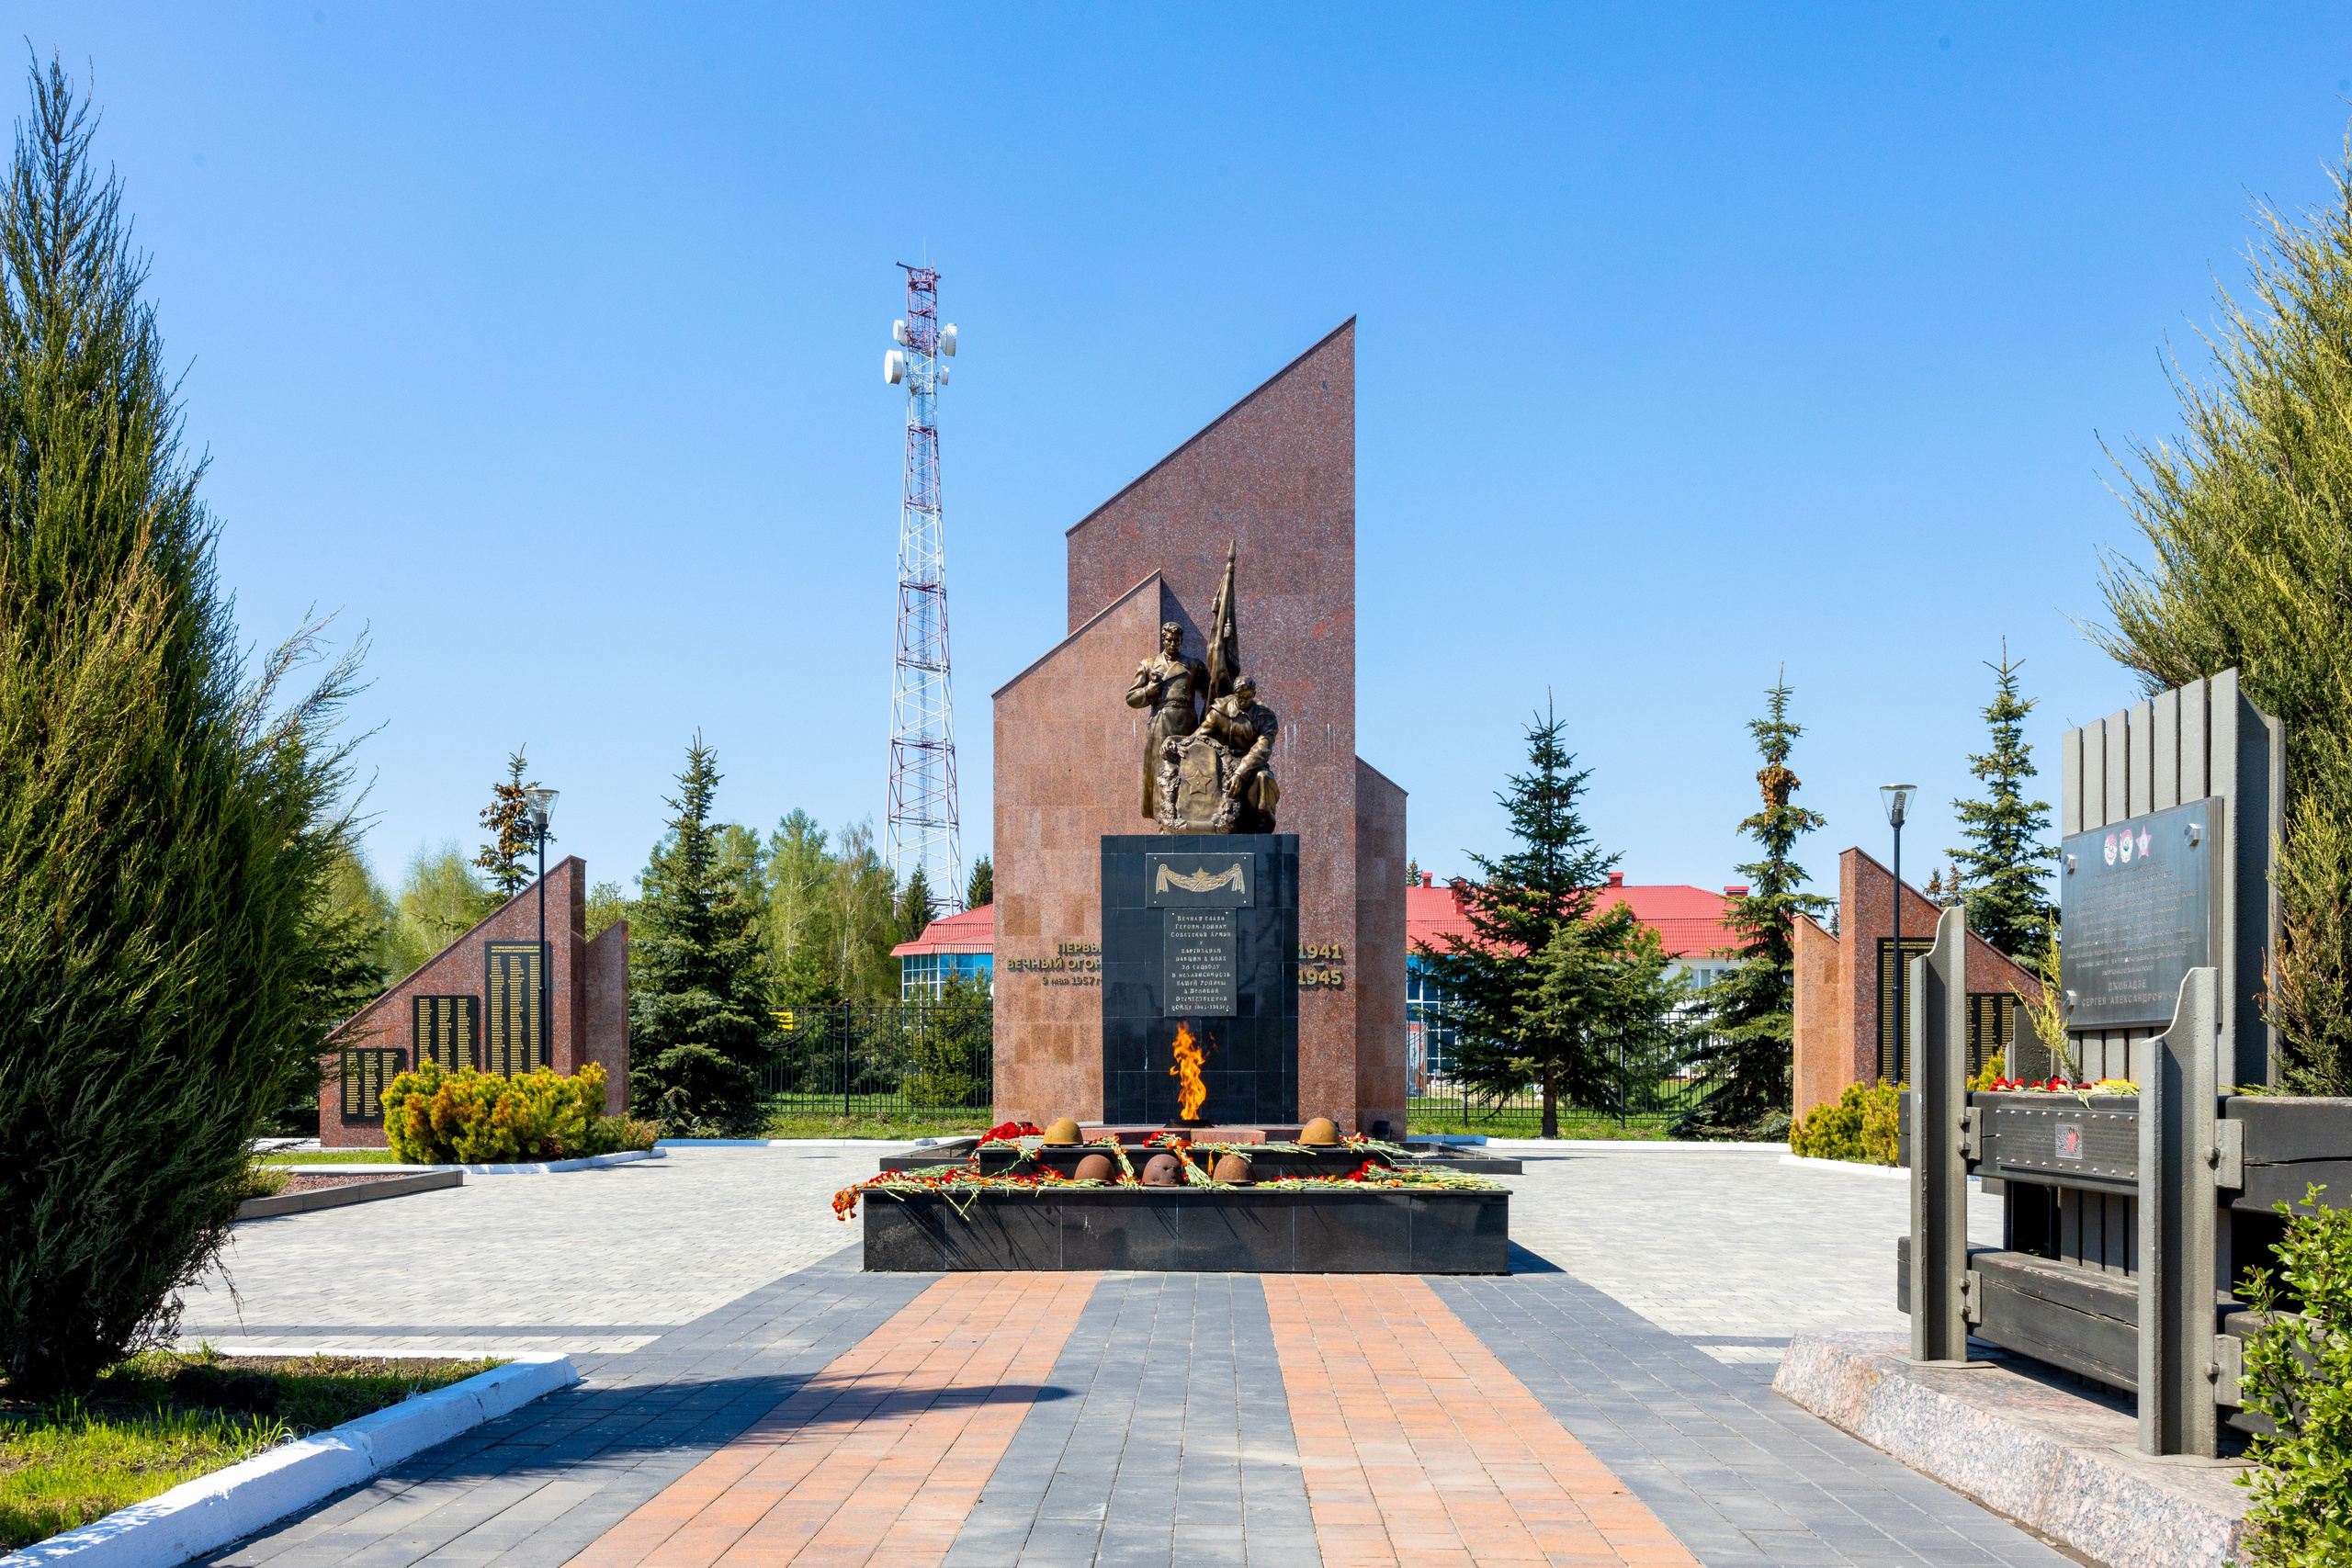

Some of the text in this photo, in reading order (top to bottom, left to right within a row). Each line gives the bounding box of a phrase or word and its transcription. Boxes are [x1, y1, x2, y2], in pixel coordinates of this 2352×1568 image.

[1057, 942, 1102, 953] ПЕРВЫ
[1298, 943, 1342, 959] 1941
[1007, 956, 1102, 969] ВЕЧНЫЙ ОГОН
[1298, 969, 1342, 986] 1945
[2108, 979, 2147, 992] ДЖОБАДЗЕ
[2081, 991, 2178, 1007] СЕРГЕЯ АЛЕКСАНДРОВИЧА
